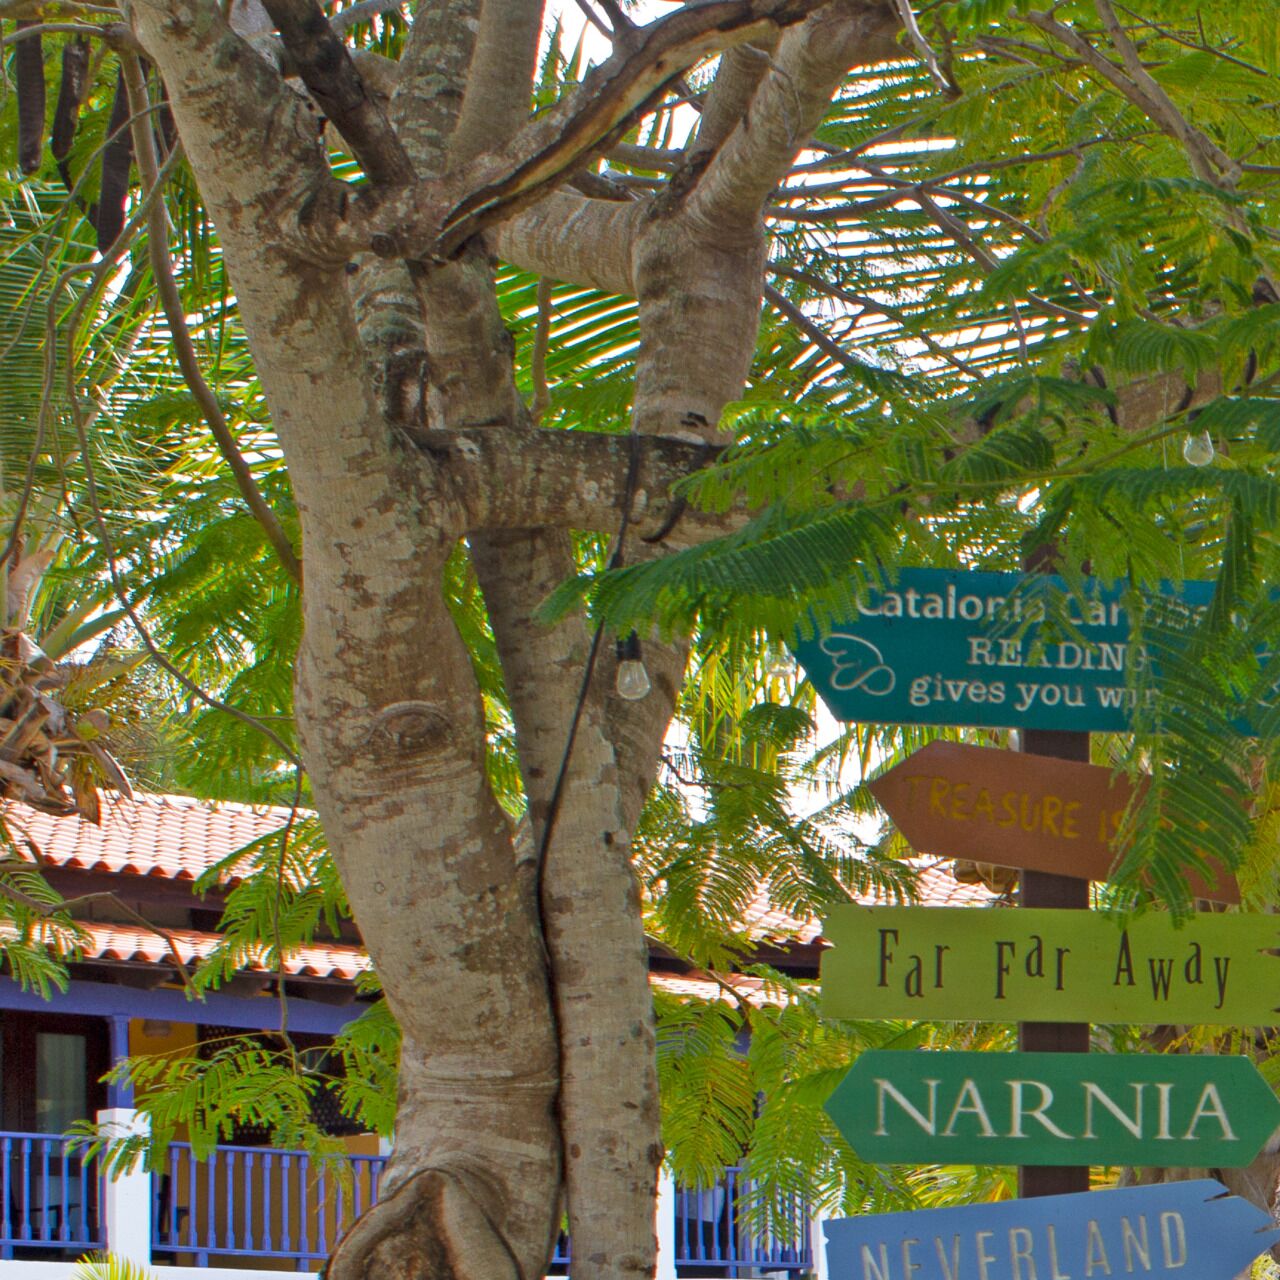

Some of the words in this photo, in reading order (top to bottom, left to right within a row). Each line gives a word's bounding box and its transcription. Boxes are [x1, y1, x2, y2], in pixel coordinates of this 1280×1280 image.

[909, 672, 1006, 707] gives
[1015, 683, 1087, 712] you
[904, 775, 1081, 839] TREASURE
[877, 928, 950, 998] Far
[994, 935, 1071, 999] Far
[1113, 930, 1231, 1009] Away
[873, 1078, 1240, 1141] NARNIA
